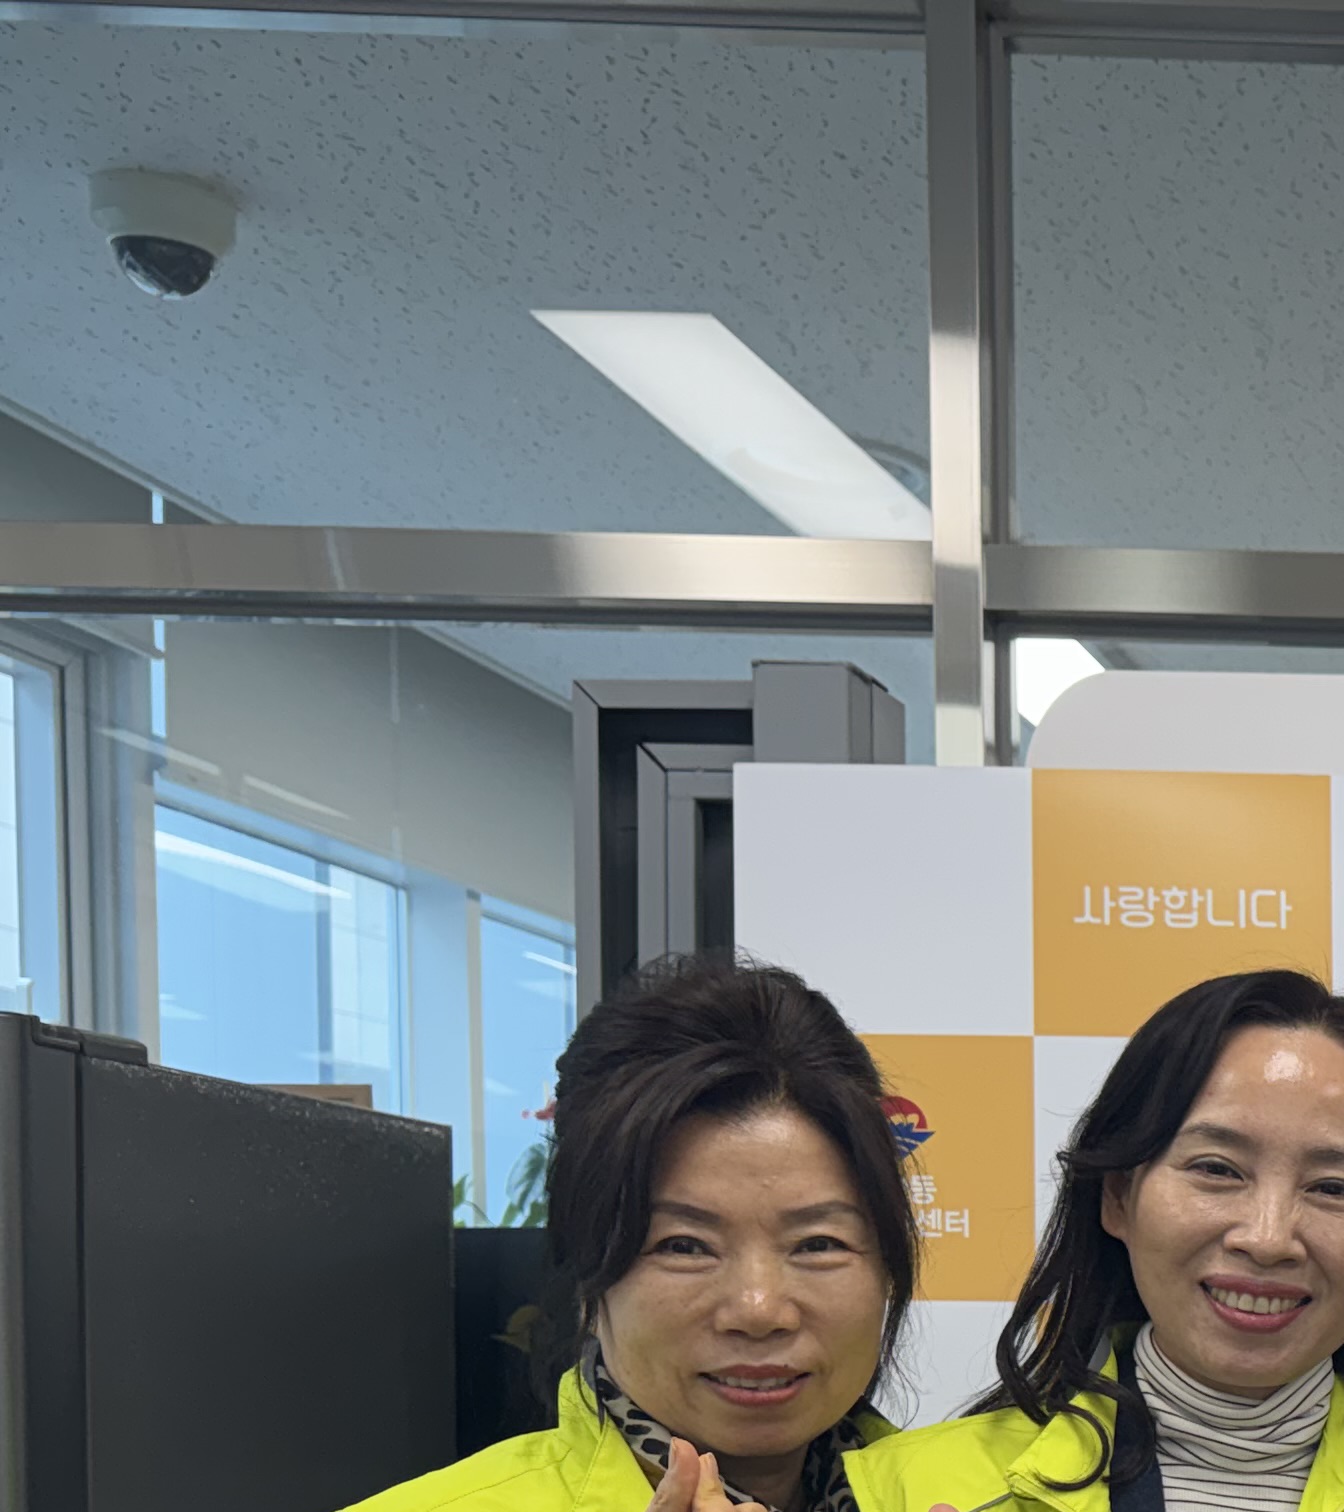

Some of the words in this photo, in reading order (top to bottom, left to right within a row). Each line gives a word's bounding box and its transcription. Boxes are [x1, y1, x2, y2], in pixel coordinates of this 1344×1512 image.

[1074, 886, 1292, 930] 사랑합니다
[906, 1174, 937, 1205] 동
[914, 1208, 970, 1239] 센터
